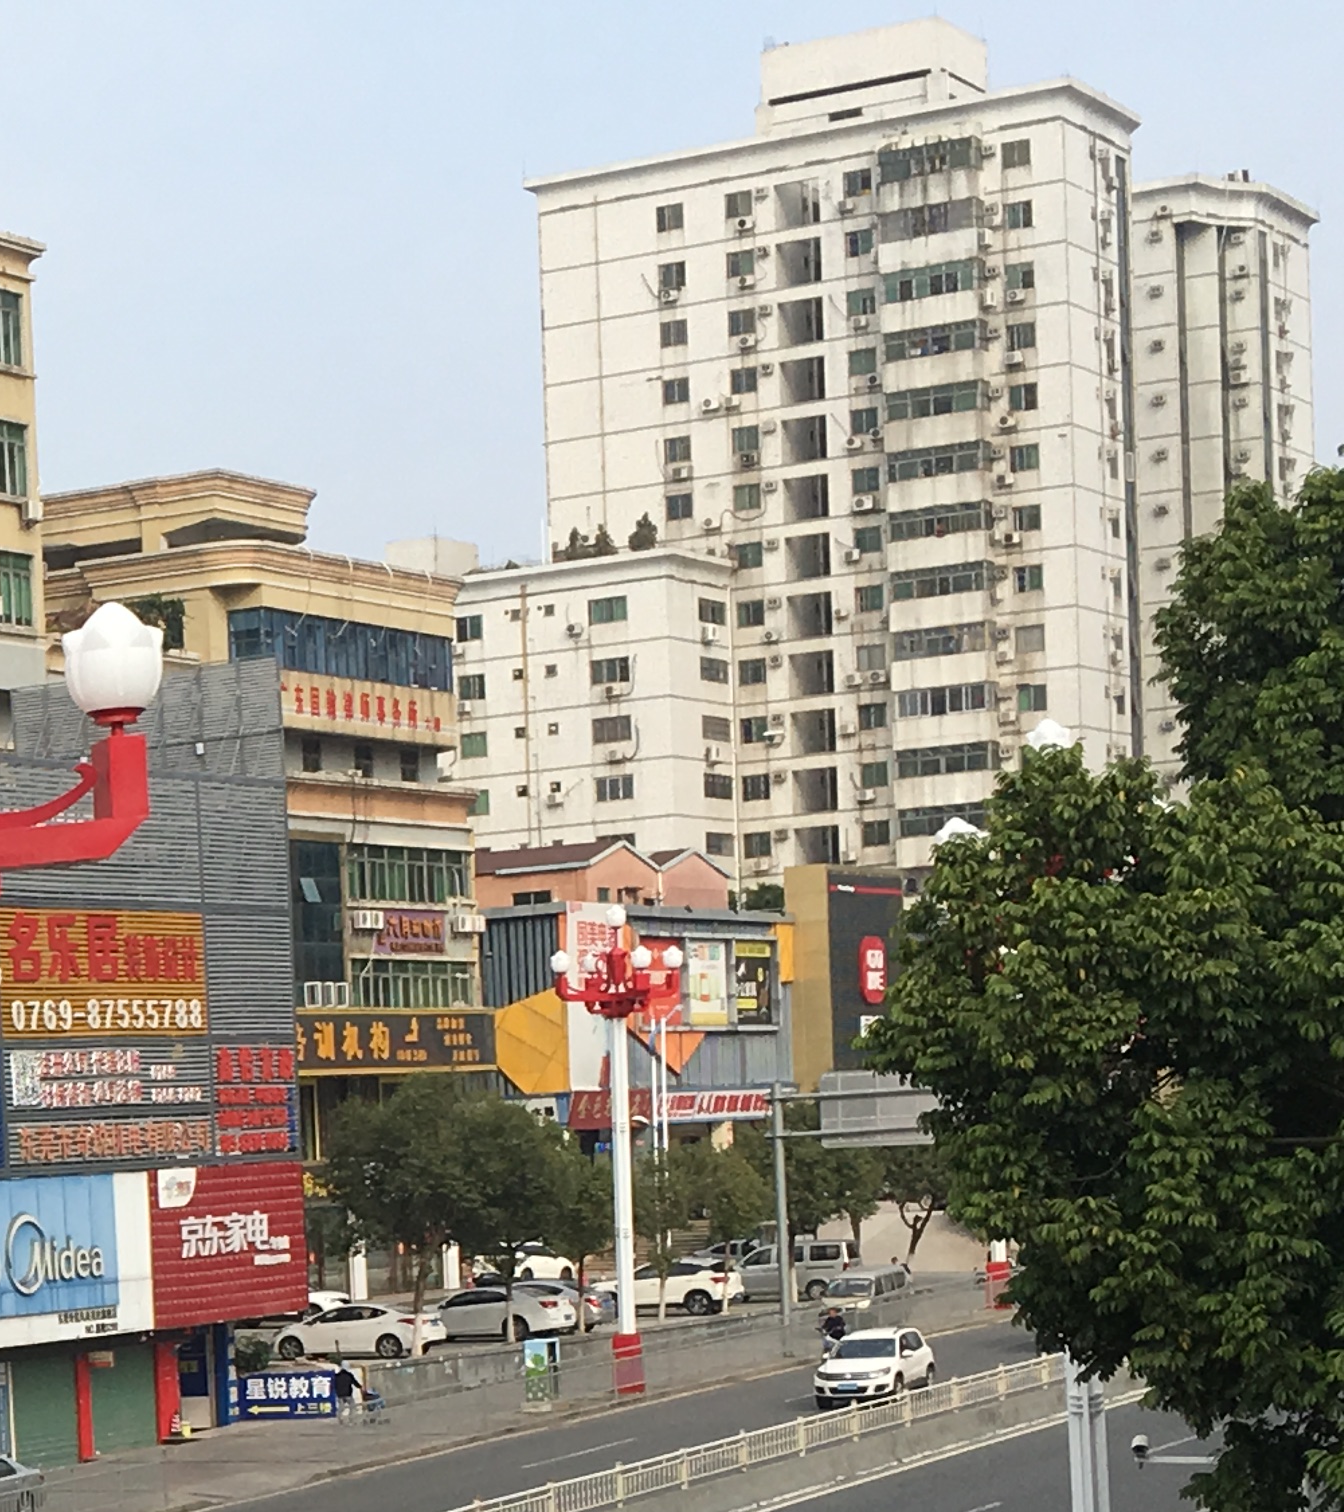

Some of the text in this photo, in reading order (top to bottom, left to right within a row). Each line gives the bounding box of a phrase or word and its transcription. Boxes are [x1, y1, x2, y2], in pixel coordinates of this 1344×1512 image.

[12, 999, 202, 1031] 0769-87555788
[179, 1210, 269, 1258] 京东家电
[26, 1234, 105, 1286] Midea
[245, 1370, 331, 1400] 星锐教育
